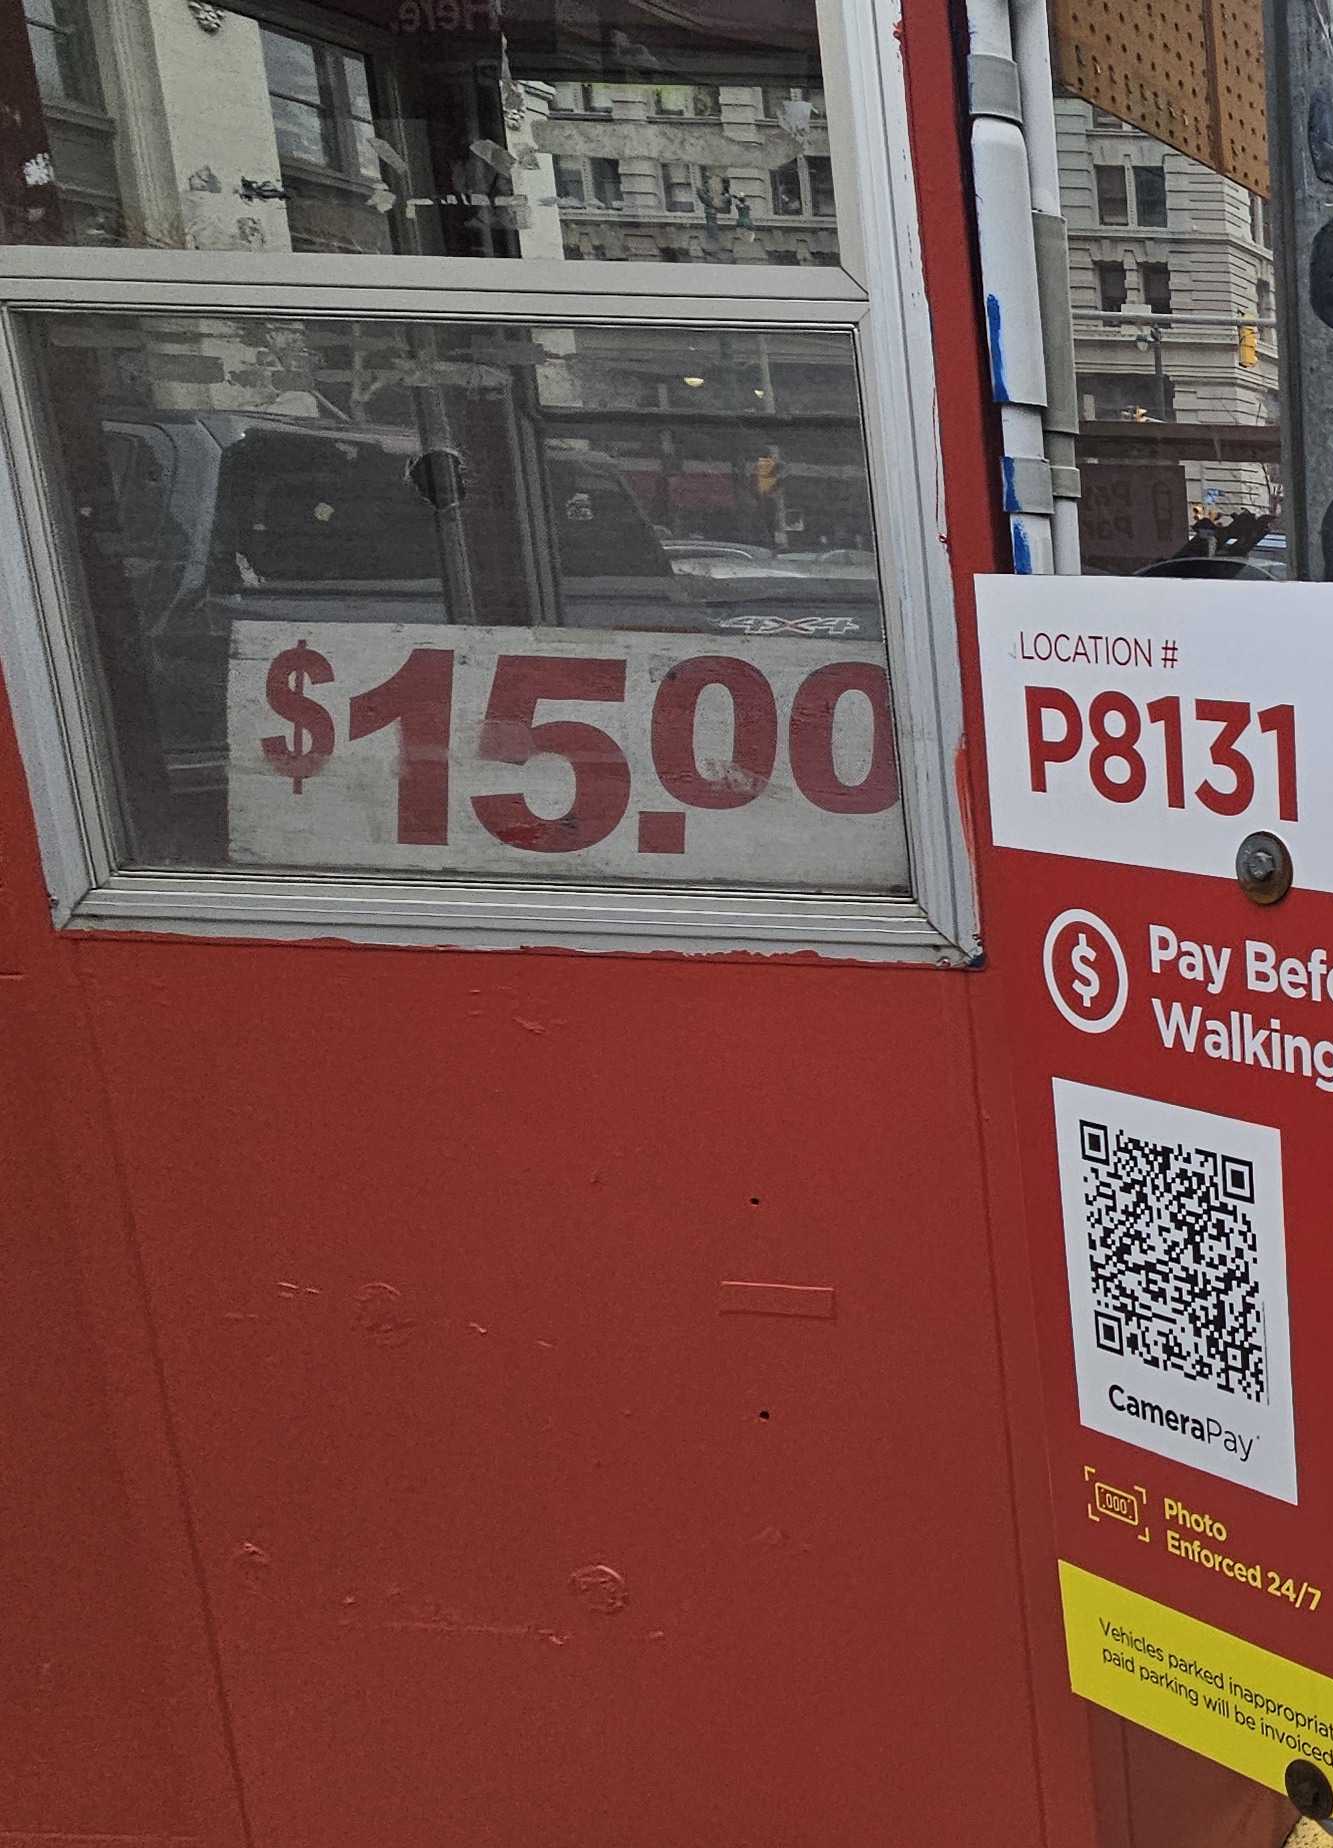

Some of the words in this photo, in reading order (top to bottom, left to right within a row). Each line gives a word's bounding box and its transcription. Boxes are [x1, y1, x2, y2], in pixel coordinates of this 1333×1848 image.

[1020, 631, 1153, 668] LOCATION
[1161, 640, 1179, 669] #
[1024, 685, 1299, 823] P8131
[1149, 924, 1232, 995] Pay
[1108, 1384, 1255, 1462] CameraPay
[1164, 1498, 1228, 1542] Photo
[1166, 1530, 1262, 1589] Enforced
[1266, 1571, 1322, 1611] 24/7
[1099, 1617, 1164, 1662] Vehicles
[1168, 1652, 1224, 1691] parked
[1102, 1648, 1135, 1673] paid
[1140, 1665, 1199, 1707] parking
[1204, 1694, 1230, 1719] will
[1235, 1705, 1256, 1731] be
